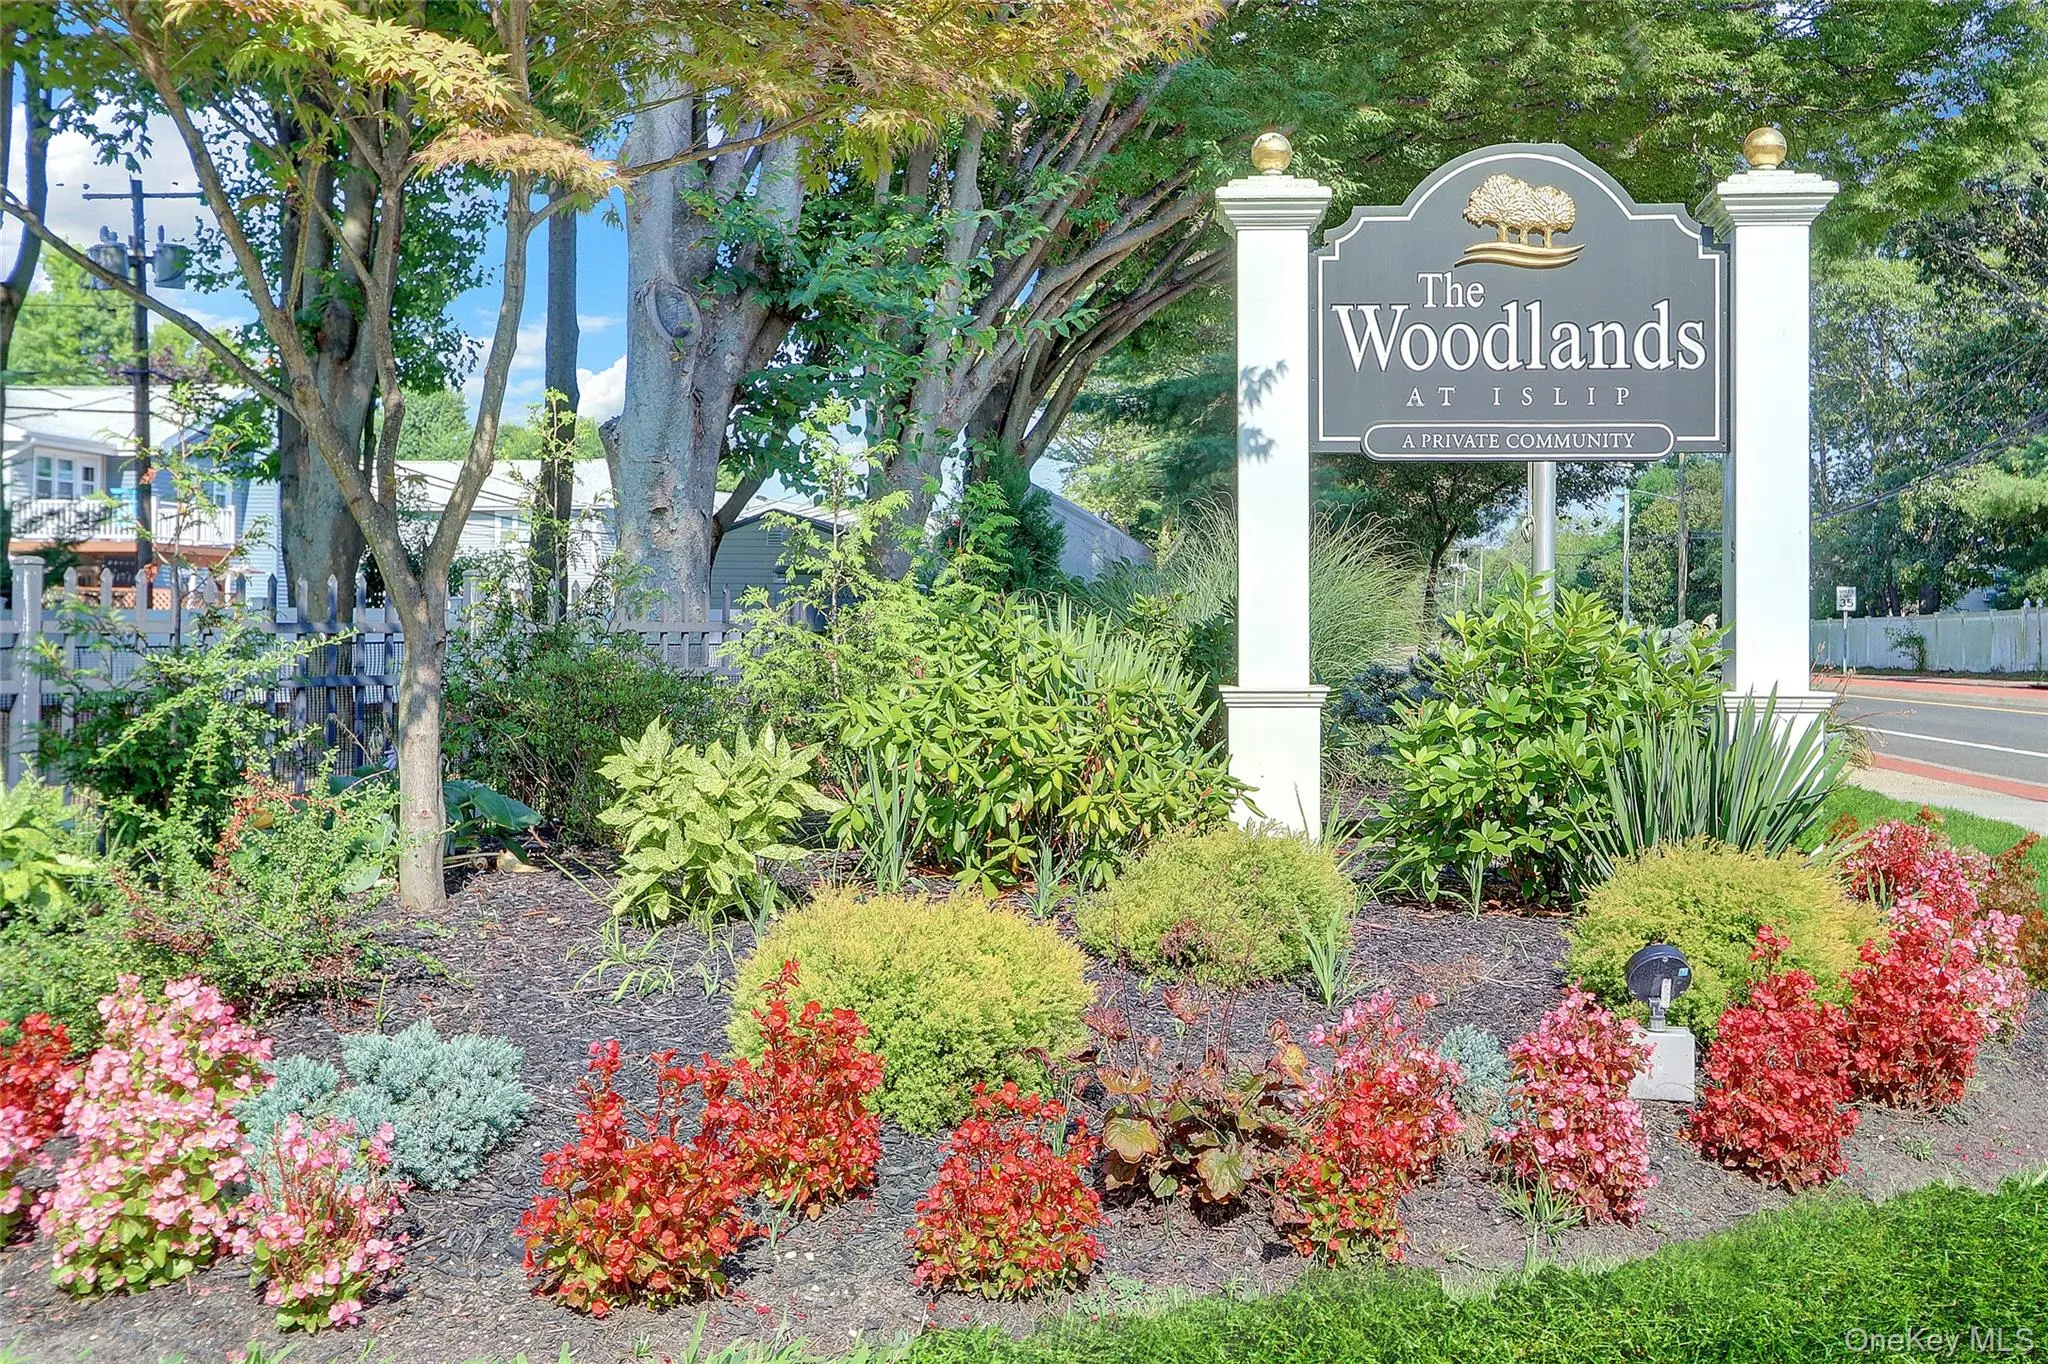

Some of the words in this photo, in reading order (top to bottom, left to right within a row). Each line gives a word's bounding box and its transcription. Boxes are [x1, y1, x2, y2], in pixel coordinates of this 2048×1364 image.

[1417, 271, 1485, 308] The
[1331, 299, 1707, 372] Woodlands
[1406, 386, 1456, 407] AT
[1493, 386, 1631, 407] ISLIP
[1402, 434, 1415, 449] A
[1421, 433, 1500, 449] PRIVATE
[1506, 433, 1636, 449] COMMUNITY
[1839, 598, 1854, 608] 35
